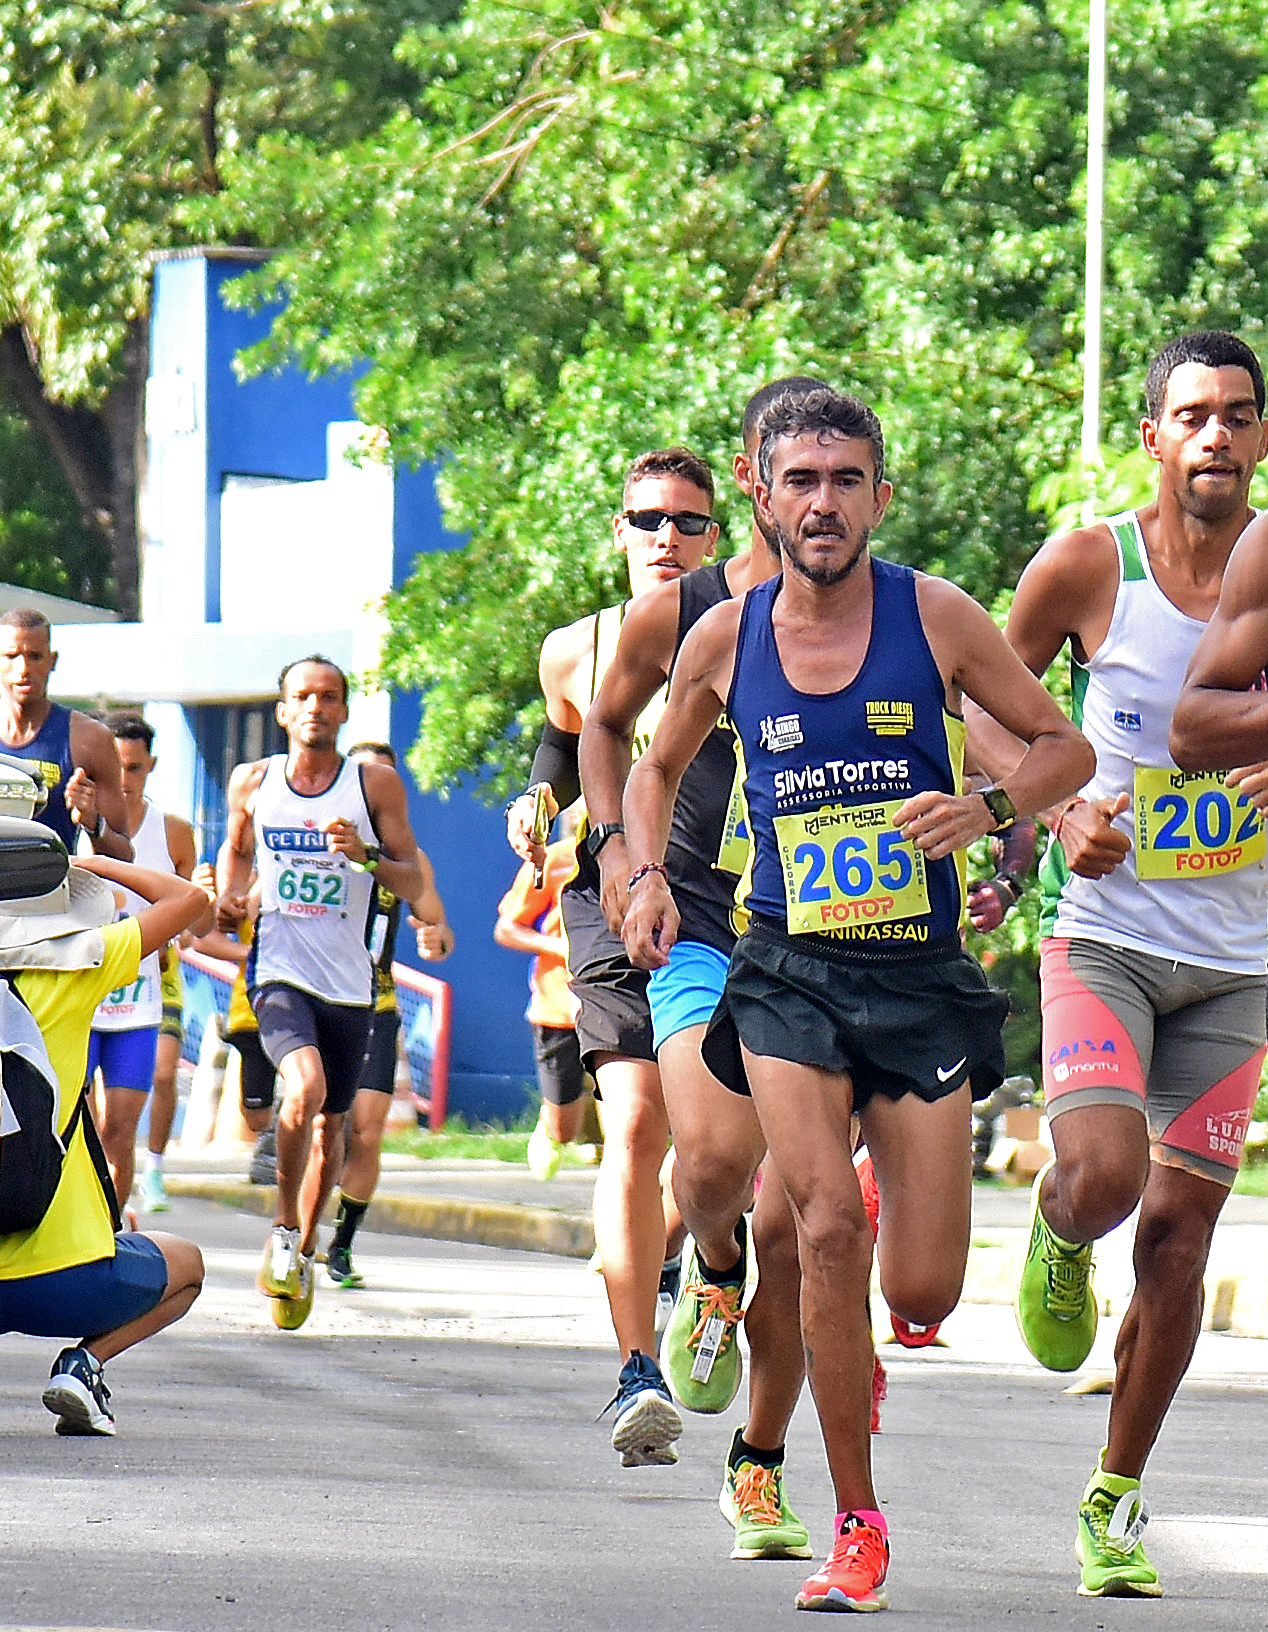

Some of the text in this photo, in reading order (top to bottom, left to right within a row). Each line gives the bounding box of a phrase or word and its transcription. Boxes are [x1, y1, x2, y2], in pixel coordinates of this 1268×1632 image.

[865, 701, 914, 716] TRUCK DIESEL
[776, 788, 844, 810] ASSESSORIA
[849, 781, 913, 794] ESPORTIVA
[804, 808, 886, 836] MENTHOR
[1152, 791, 1260, 850] 202
[268, 832, 324, 847] PETRI
[793, 829, 913, 903] 265
[1176, 847, 1243, 871] FOTOP
[278, 869, 343, 905] 652
[782, 845, 798, 904] CICORRE
[820, 896, 895, 924] FOTOP
